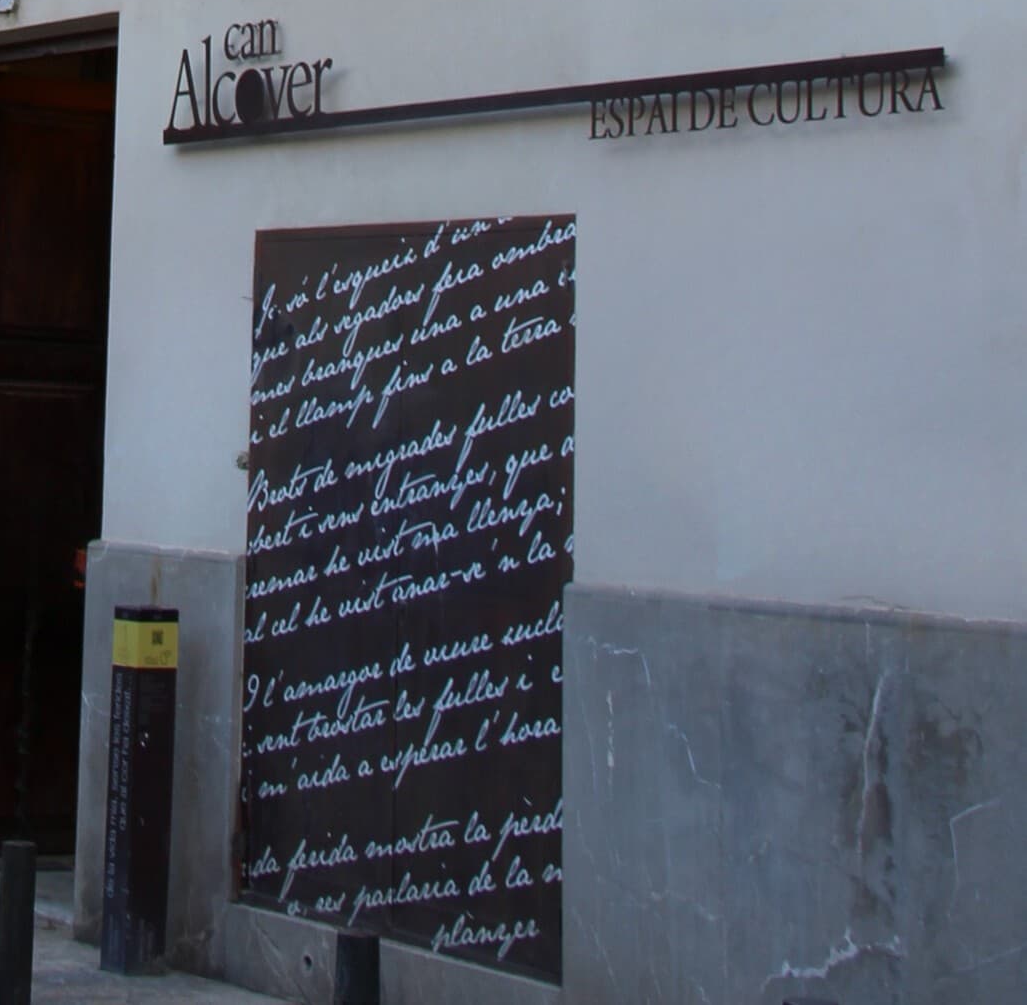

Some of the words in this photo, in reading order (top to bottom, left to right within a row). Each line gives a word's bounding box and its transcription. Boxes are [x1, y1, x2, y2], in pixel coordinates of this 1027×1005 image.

[224, 18, 282, 61] can
[168, 34, 333, 131] Alcover
[589, 91, 679, 140] ESPAI
[687, 85, 738, 132] DE
[747, 65, 945, 127] CULTURA
[301, 332, 404, 391] branques
[410, 314, 463, 345] una
[469, 305, 487, 322] a
[493, 280, 550, 312] una
[296, 385, 374, 429] llamp
[440, 358, 458, 375] a
[465, 335, 493, 366] la
[501, 316, 562, 354] terra
[313, 458, 338, 492] de
[503, 444, 553, 501] que
[527, 530, 557, 565] la
[246, 565, 319, 600] remar
[389, 642, 417, 678] de
[515, 654, 534, 691] i
[357, 760, 374, 778] a
[464, 810, 491, 844] la
[468, 860, 497, 896] de
[505, 855, 534, 890] la
